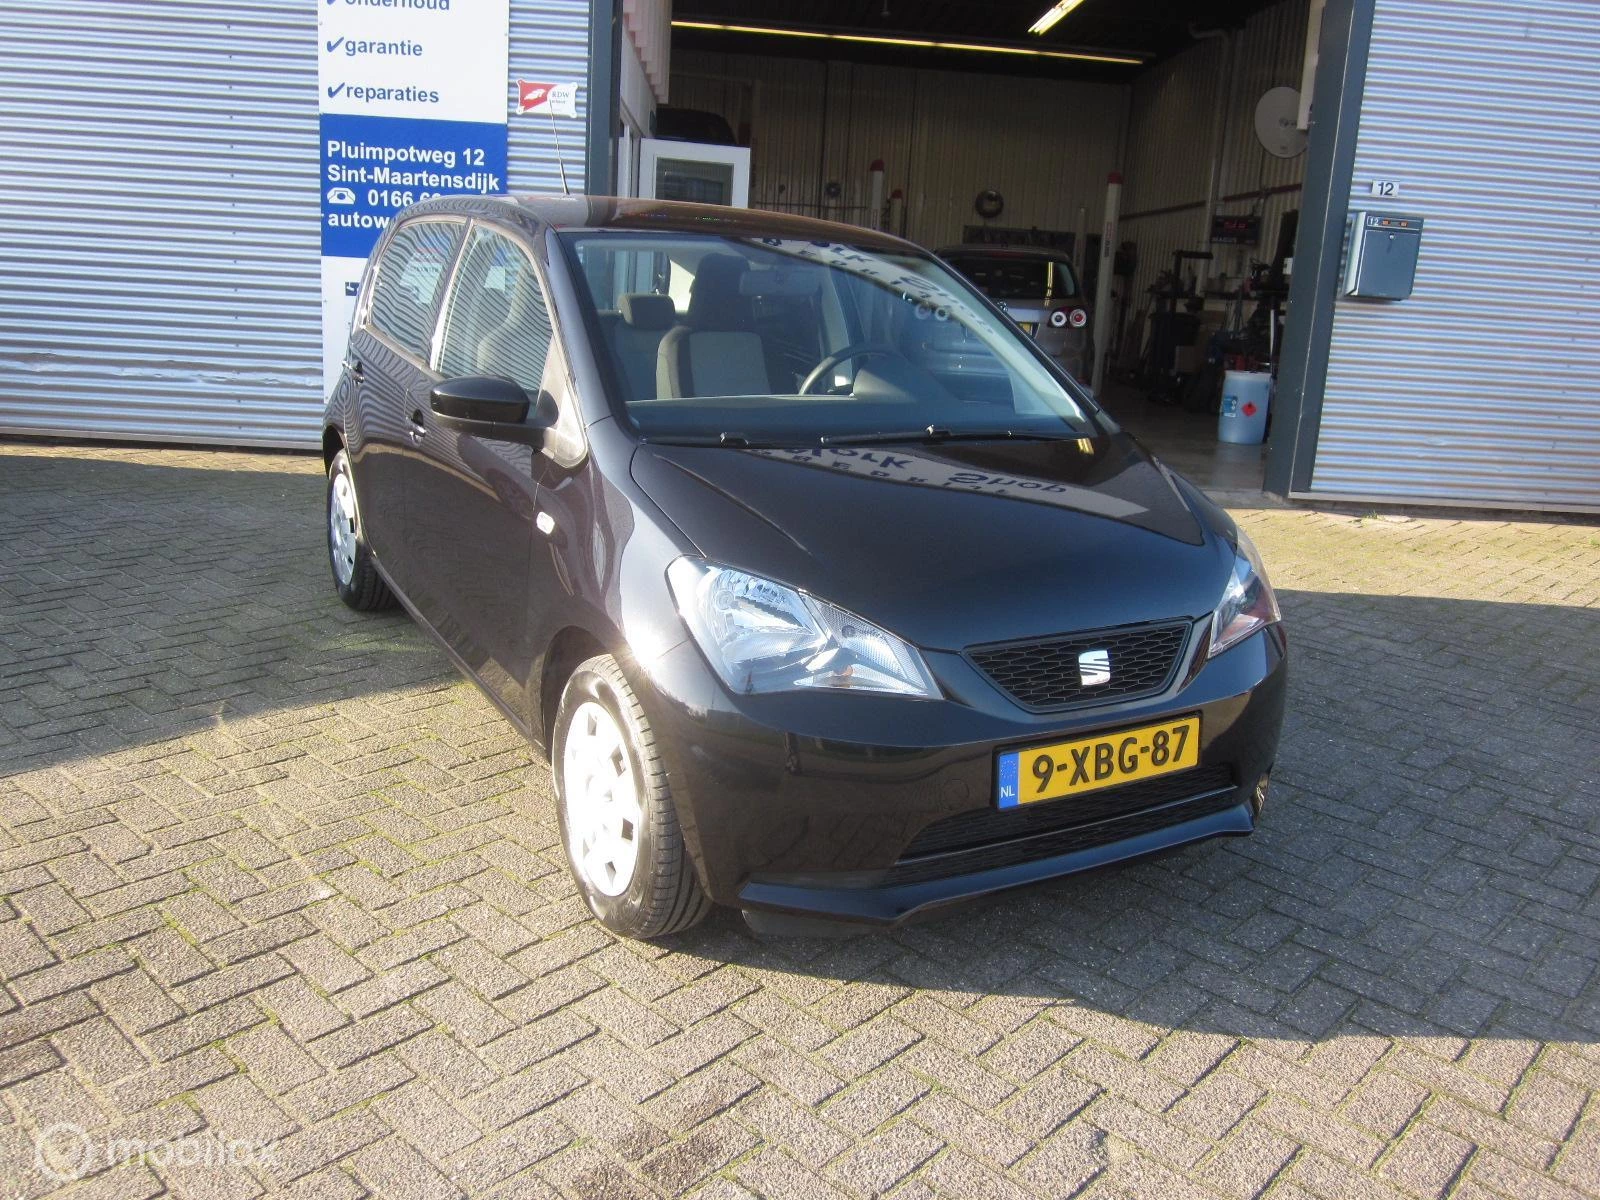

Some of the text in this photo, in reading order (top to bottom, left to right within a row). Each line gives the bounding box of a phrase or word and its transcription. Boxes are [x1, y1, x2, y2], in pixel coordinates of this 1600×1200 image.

[345, 40, 423, 56] garantie
[346, 86, 439, 103] reparaties
[327, 140, 485, 168] Pluimpotweg 12
[327, 164, 500, 194] Sint-Maartensdijk
[1378, 181, 1394, 196] 12
[367, 189, 414, 207] 0166
[1369, 217, 1379, 227] 12
[1032, 724, 1190, 794] 9-XBG-87
[1000, 785, 1016, 798] NL
